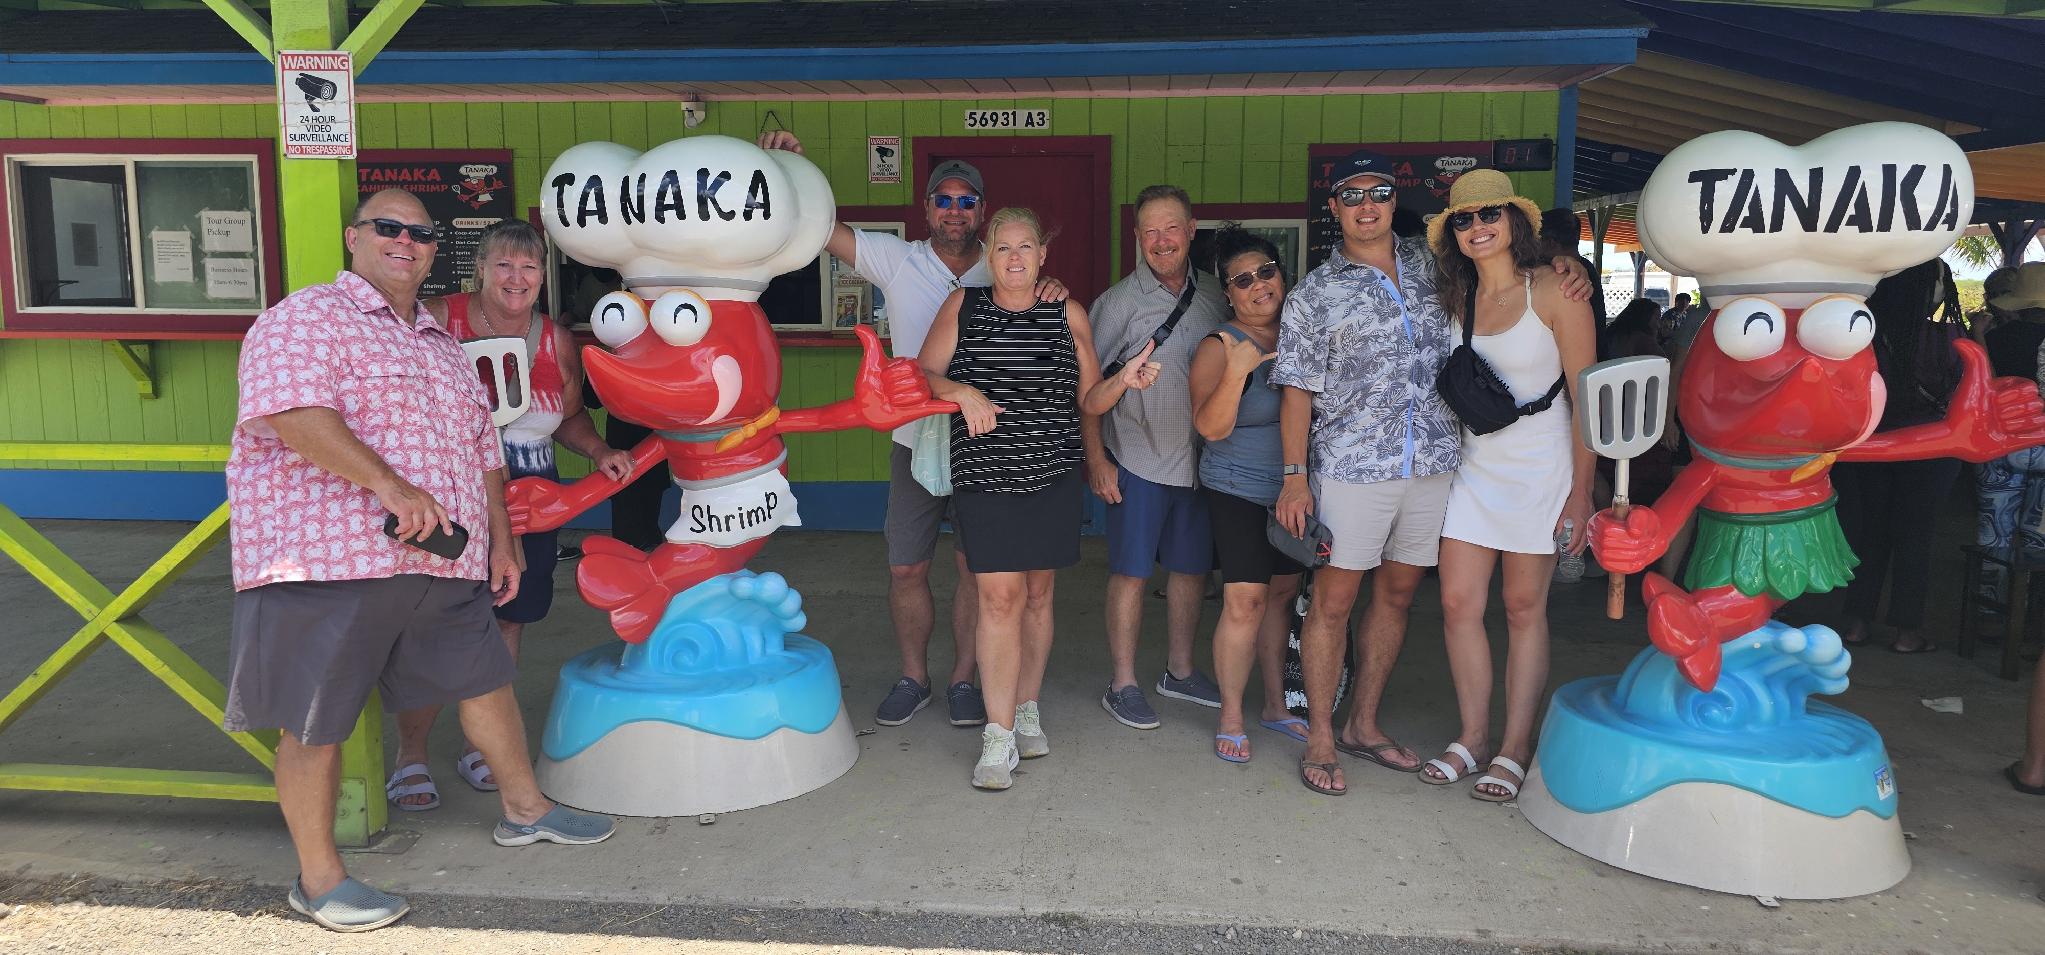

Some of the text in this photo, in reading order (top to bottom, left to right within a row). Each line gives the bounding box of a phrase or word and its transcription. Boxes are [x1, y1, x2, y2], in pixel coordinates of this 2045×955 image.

[282, 56, 349, 70] WARNING
[299, 115, 336, 124] 24 HOUR
[968, 111, 1046, 127] 56931 A3
[305, 125, 332, 133] VIDEO
[289, 133, 349, 143] SURVEILLANCE
[288, 145, 351, 155] NO TRESPASSING
[1440, 159, 1474, 167] TANAKA
[359, 167, 442, 182] TANAKA
[464, 167, 495, 175] TANAKA
[404, 184, 449, 193] SHRIMP
[551, 167, 771, 228] TANAKA
[1688, 164, 1959, 234] TANAKA
[207, 217, 246, 226] Tour Group
[207, 228, 231, 237] Pickup
[689, 491, 778, 534] Shrimp
